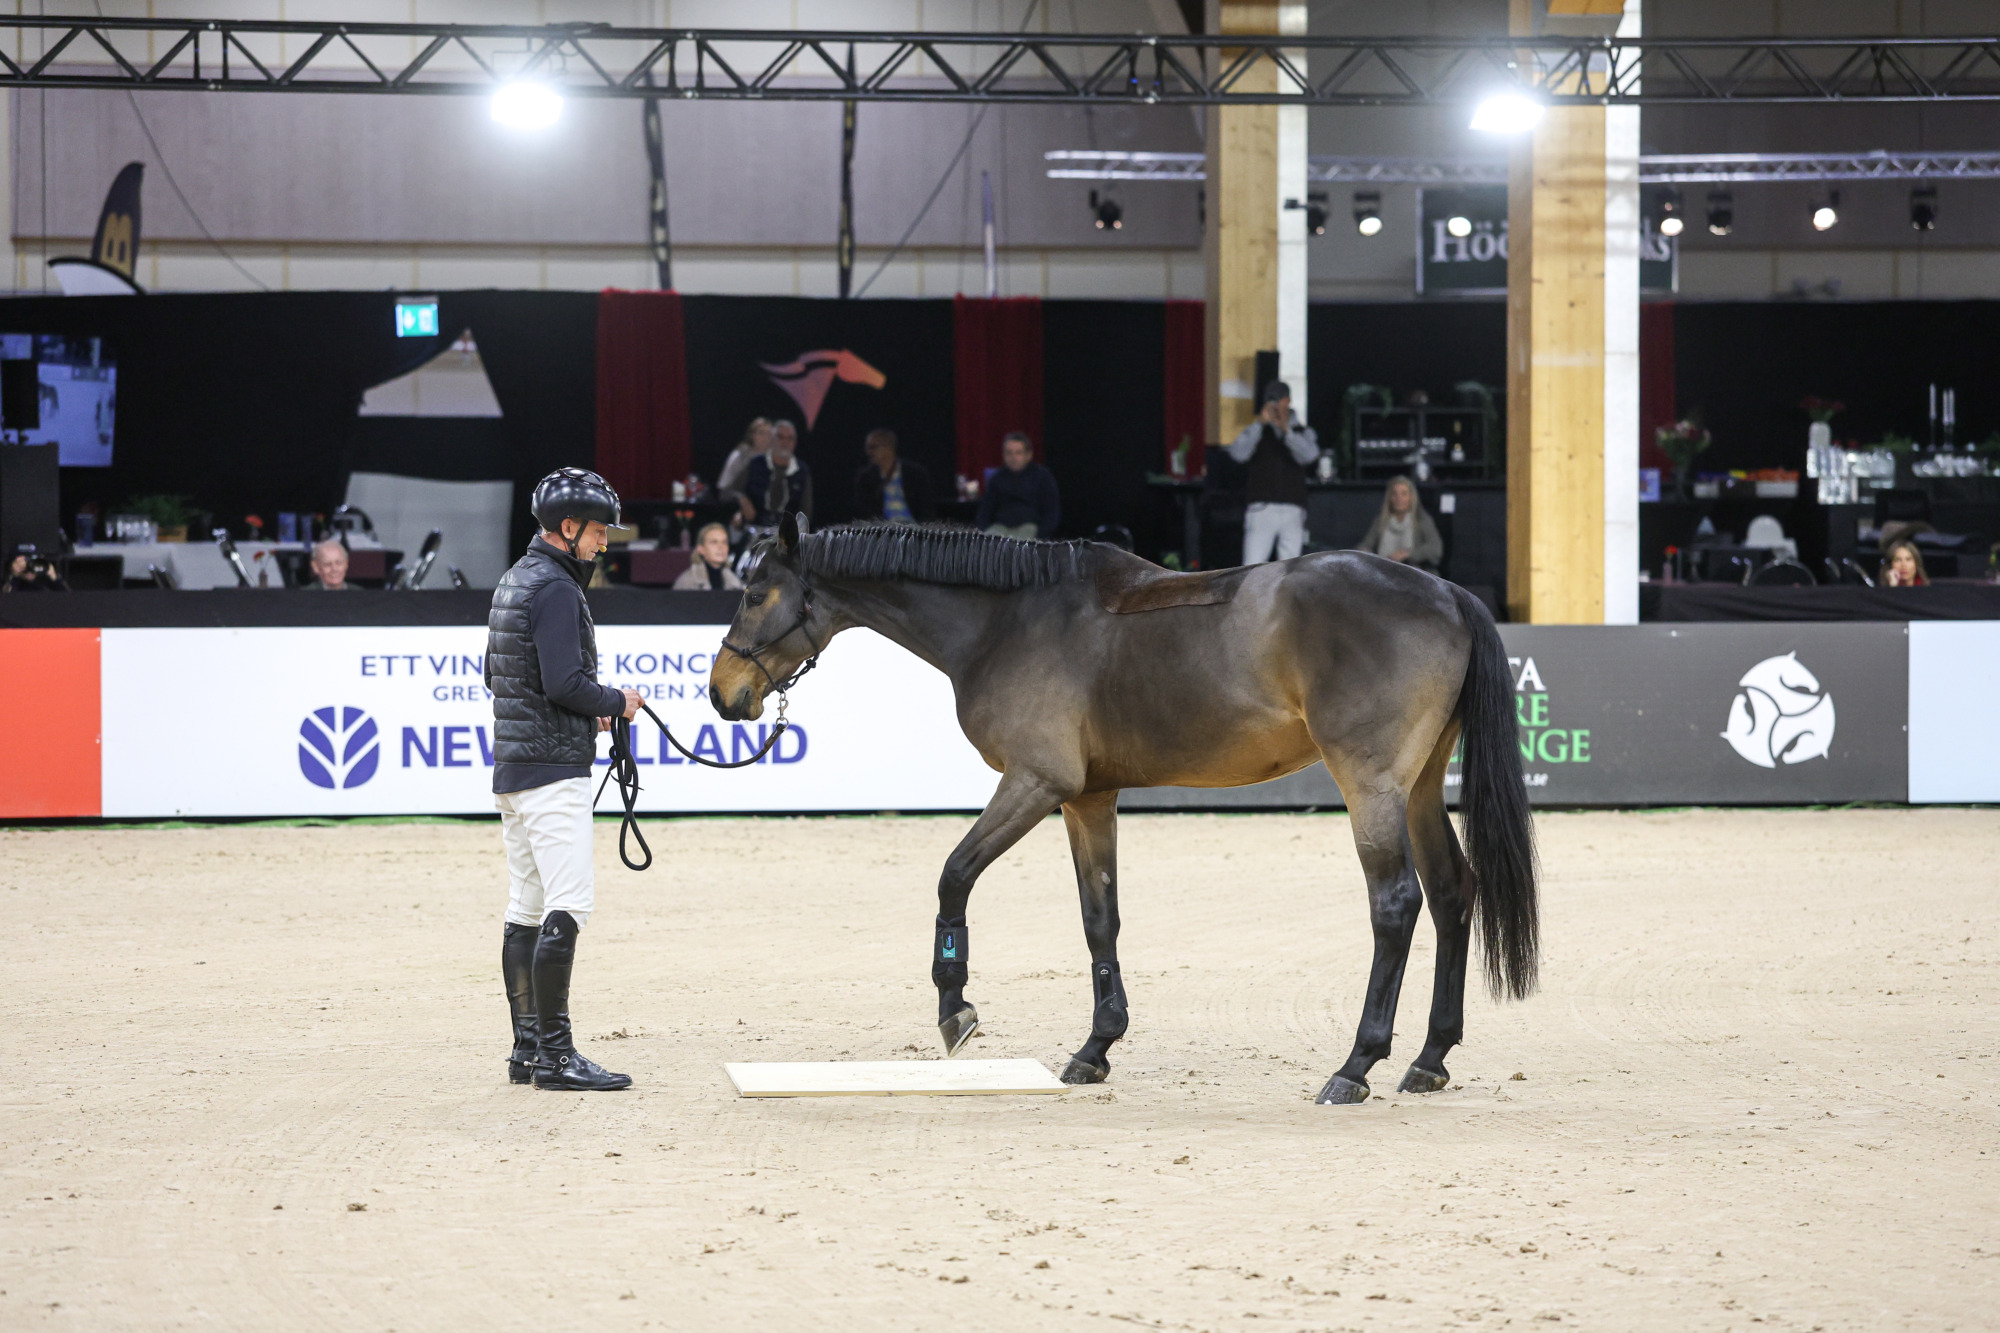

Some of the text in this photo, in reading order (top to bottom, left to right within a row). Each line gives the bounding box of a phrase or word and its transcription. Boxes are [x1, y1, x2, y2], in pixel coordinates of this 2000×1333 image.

[361, 655, 422, 676] ETT
[616, 653, 717, 675] KONC
[594, 723, 808, 765] LLAND
